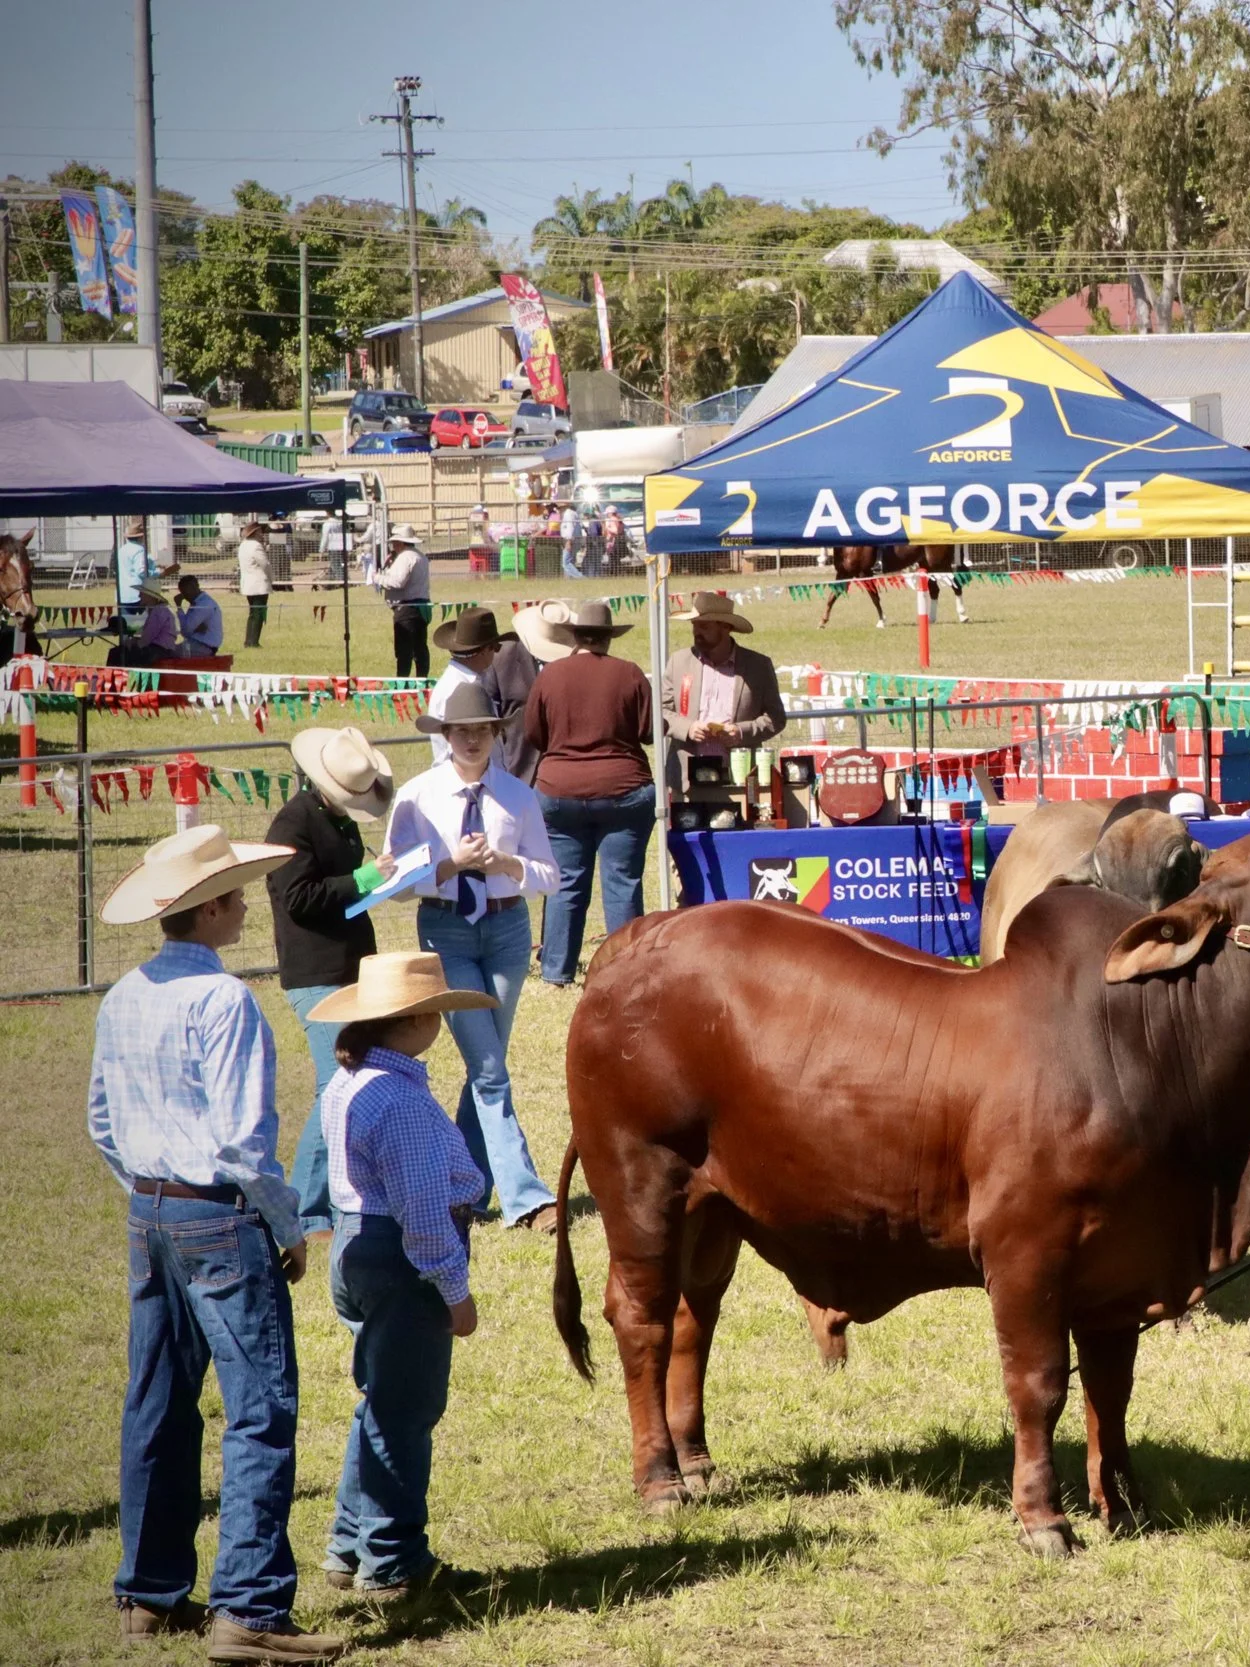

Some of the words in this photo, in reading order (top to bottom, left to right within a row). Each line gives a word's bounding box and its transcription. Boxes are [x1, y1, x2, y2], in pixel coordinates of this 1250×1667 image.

[928, 449, 1013, 463] AGFORCE
[802, 480, 1143, 538] AGFORCE
[835, 856, 954, 879] COLEMA
[832, 883, 902, 901] STOCK
[908, 882, 959, 897] FEED
[850, 915, 888, 925] Towers,
